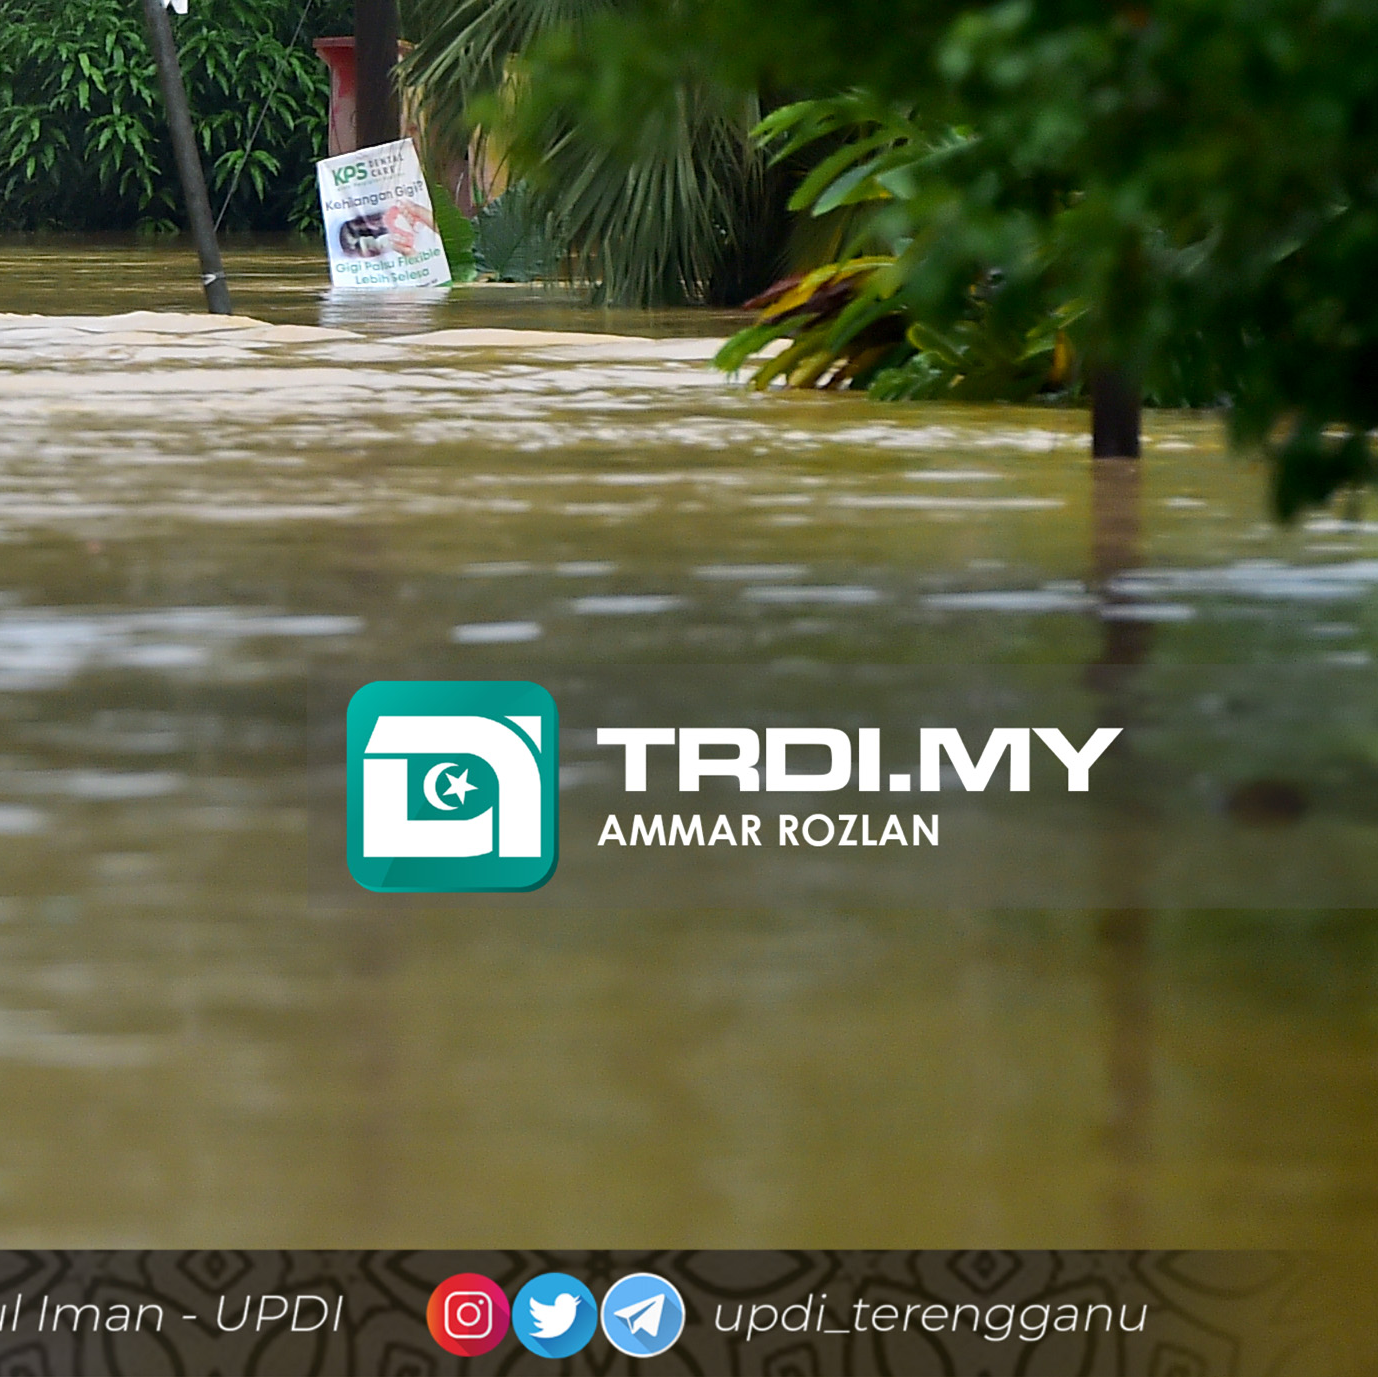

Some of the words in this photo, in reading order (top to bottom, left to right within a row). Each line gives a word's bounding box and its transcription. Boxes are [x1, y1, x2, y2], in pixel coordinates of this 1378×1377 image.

[368, 153, 404, 168] DENTAL
[331, 162, 369, 187] KPS
[335, 260, 362, 274] Gigi
[365, 259, 396, 271] Palsu
[398, 248, 442, 266] Flexible
[355, 272, 390, 285] Lebih
[391, 267, 430, 283] Selesa
